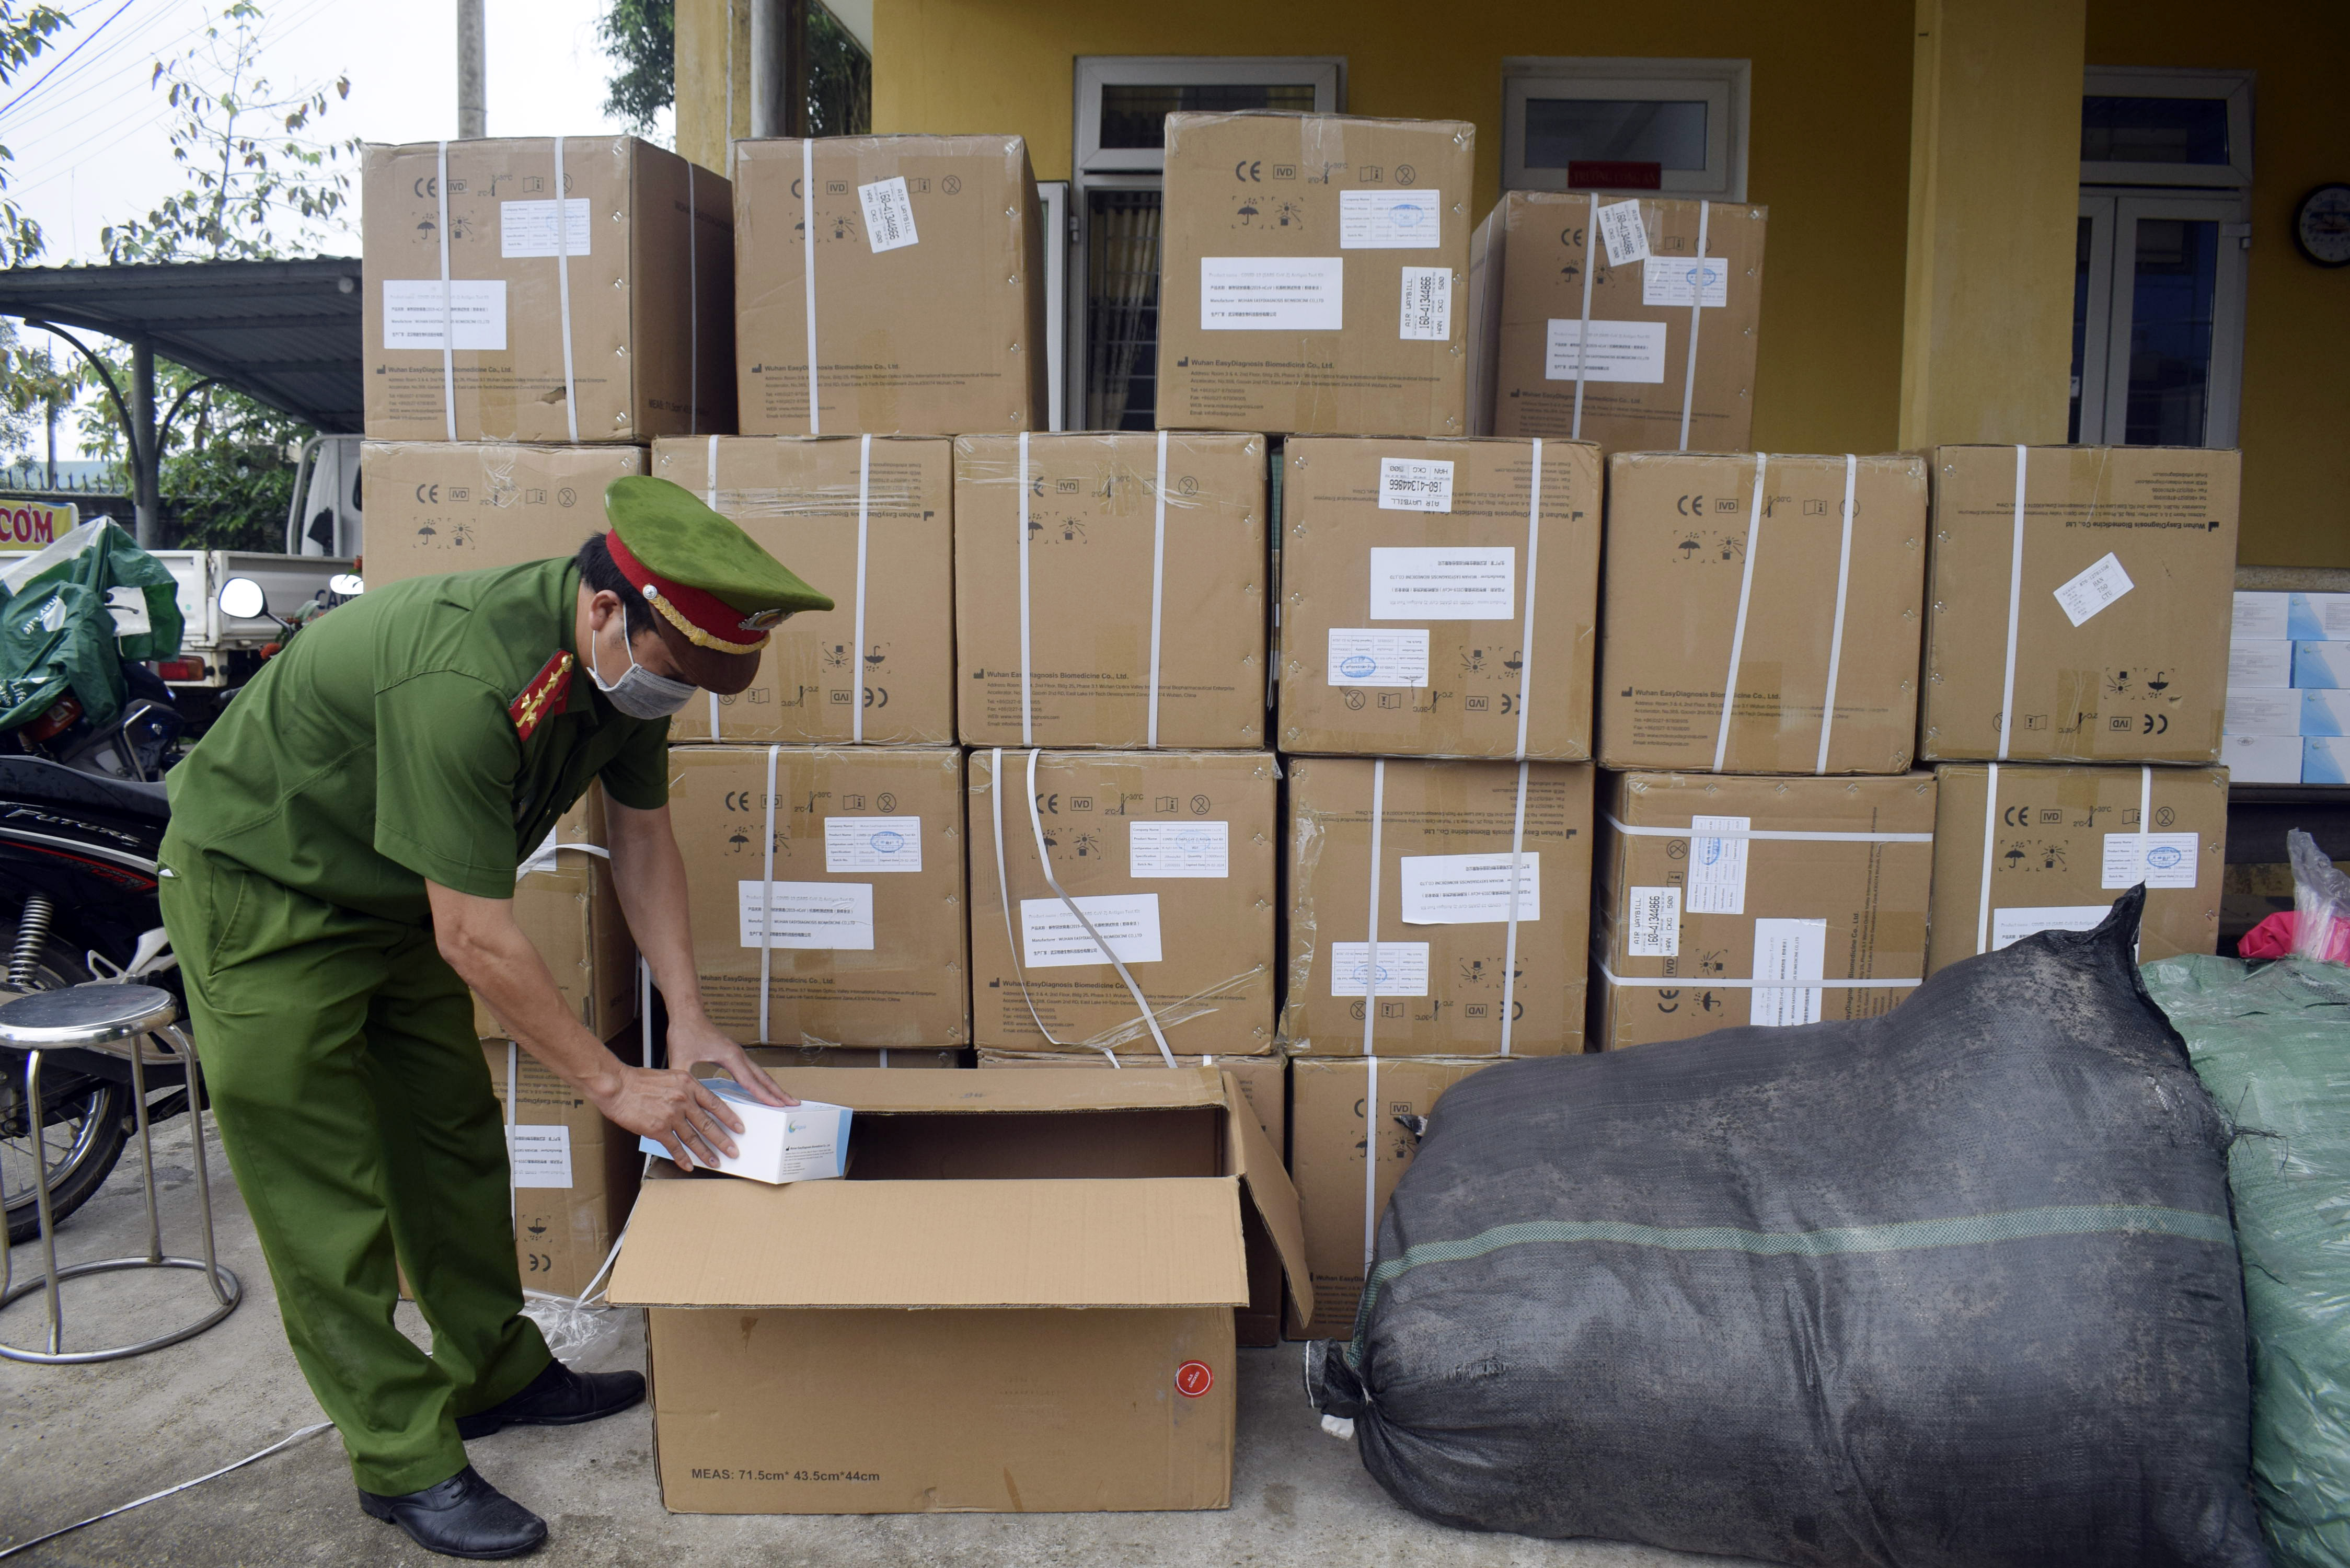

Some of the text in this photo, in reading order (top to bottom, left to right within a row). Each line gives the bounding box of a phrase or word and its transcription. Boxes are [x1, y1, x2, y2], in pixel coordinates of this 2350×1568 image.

[1236, 160, 1261, 182] CE
[1276, 167, 1293, 177] IVD
[414, 177, 436, 198] CE
[451, 183, 464, 192] IVD
[830, 183, 845, 192] IVD
[866, 189, 874, 203] HAN
[879, 191, 900, 240] 160-41344866
[901, 204, 912, 234] WAYBILL
[1561, 228, 1583, 247] CE
[1419, 276, 1431, 329] 160-41344866
[1216, 360, 1263, 368] EasyDiagnosis
[1059, 482, 1076, 490] IVD
[1389, 479, 1442, 492] 160-41344866
[417, 483, 439, 504] CE
[452, 490, 467, 499] IVD
[1677, 494, 1703, 516] CE
[1718, 502, 1735, 511] IVD
[1494, 510, 1543, 518] EyDiagnosis
[0, 503, 54, 544] CƠM
[2134, 522, 2182, 530] EasyDiagnosis
[2092, 577, 2104, 587] HAN
[2097, 583, 2108, 594] 750
[2101, 590, 2112, 601] CTU
[11, 682, 27, 704] Life
[833, 693, 849, 701] IVD
[1660, 690, 1708, 699] EasyDiagnosis
[1469, 698, 1485, 708] IVD
[2112, 720, 2129, 729] IVD
[2143, 714, 2168, 735] CE
[725, 791, 750, 812] CE
[1035, 793, 1058, 814] CE
[1074, 800, 1090, 809] IVD
[2004, 806, 2029, 827] CE
[2043, 812, 2059, 821] IVD
[1492, 828, 1540, 837] Easygnosis
[1648, 895, 1660, 946] 160-41344866
[1848, 940, 1857, 979] Biomedicine
[1666, 959, 1676, 974] IVD
[1026, 981, 1072, 989] EasyDiagnosis
[1657, 989, 1679, 1013] CE
[1468, 1007, 1484, 1015] IVD
[529, 1253, 551, 1272] CE
[692, 1469, 734, 1479] MEAS:
